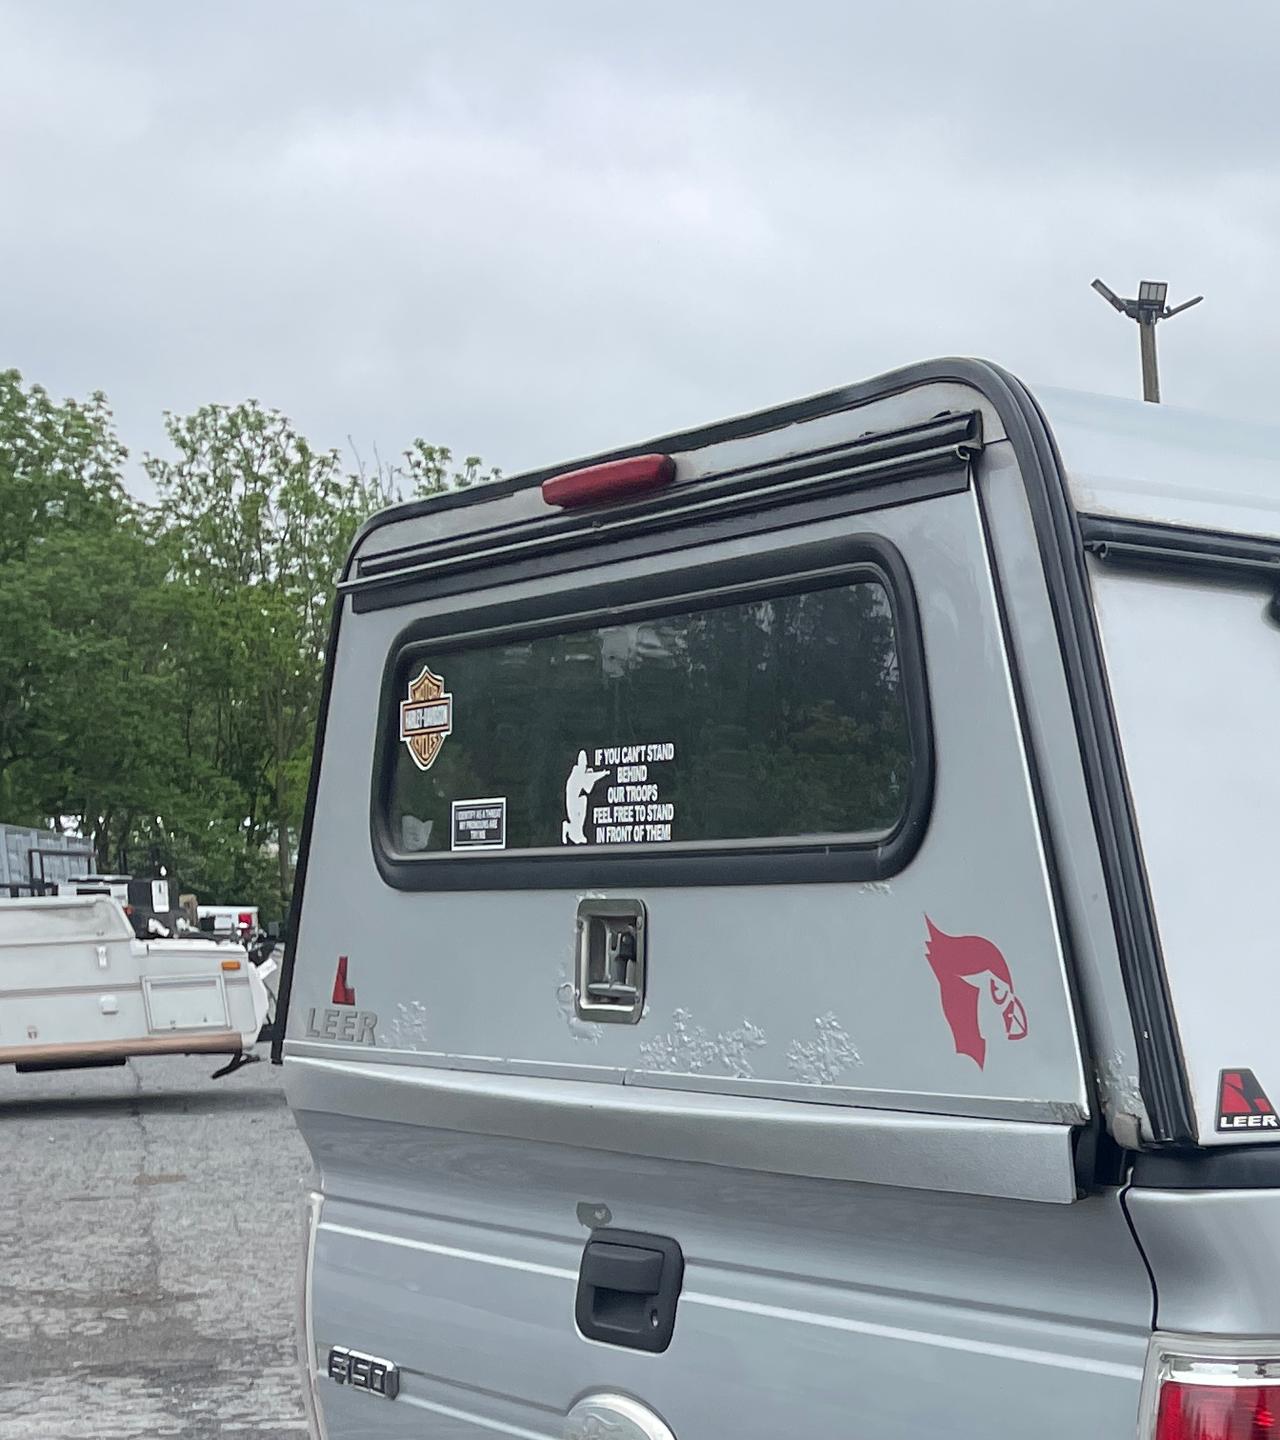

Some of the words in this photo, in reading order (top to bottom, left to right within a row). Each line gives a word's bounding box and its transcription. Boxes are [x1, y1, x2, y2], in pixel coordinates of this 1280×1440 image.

[595, 749, 603, 766] IF
[604, 747, 621, 764] YOU
[622, 745, 646, 763] CAN'T
[647, 743, 674, 762] STAND
[617, 765, 647, 783] BEHIND
[607, 786, 625, 803] OUR
[626, 784, 658, 803] TROOPS
[593, 806, 612, 824] FEEL
[614, 805, 634, 823] FREE
[635, 804, 646, 821] TO
[647, 803, 674, 821] STAND
[596, 827, 605, 843] IN
[606, 825, 632, 843] FRONT
[633, 825, 645, 842] OF
[645, 824, 671, 841] THEM!
[304, 1007, 379, 1046] LEER
[1220, 1114, 1279, 1128] LEER
